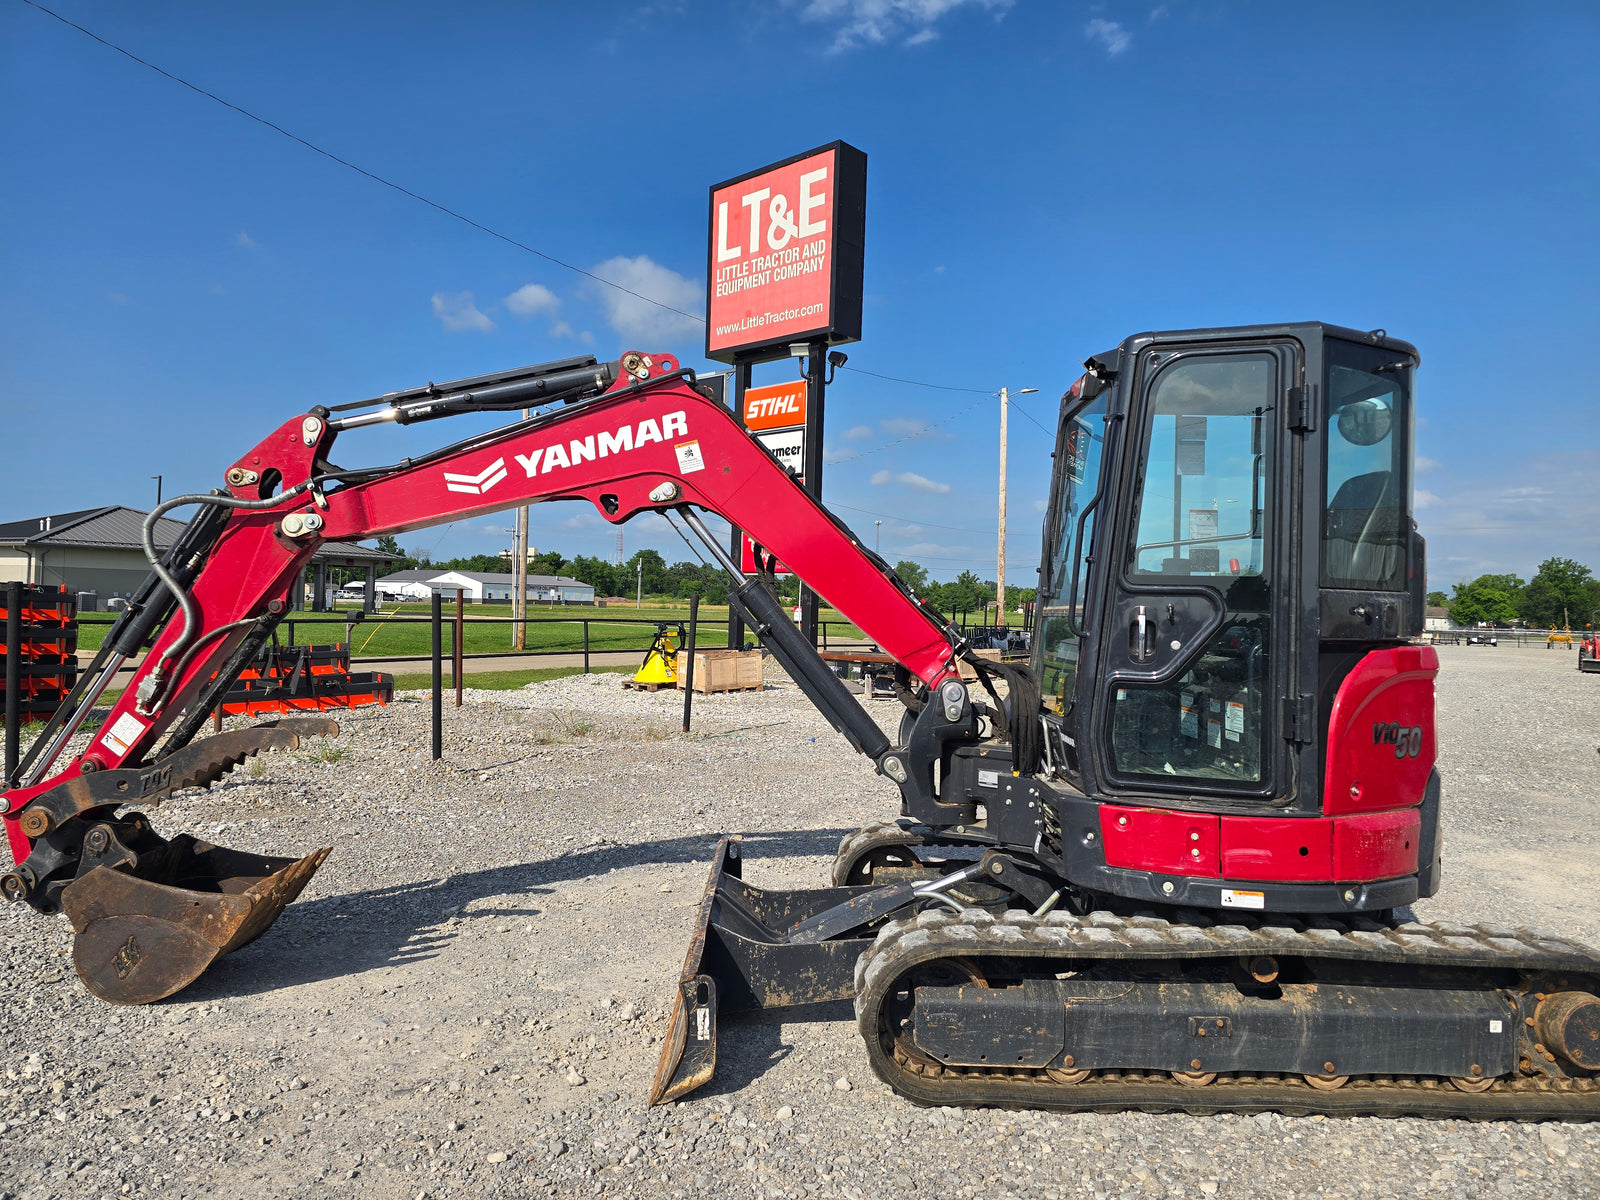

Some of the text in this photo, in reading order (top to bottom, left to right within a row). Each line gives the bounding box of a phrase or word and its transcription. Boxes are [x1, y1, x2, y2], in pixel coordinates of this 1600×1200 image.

[717, 166, 828, 263] LT&E
[716, 239, 826, 283] LITTLE TRACTOR AND
[716, 255, 825, 297] EQUIPMENT COMPANY
[716, 302, 823, 336] www.LittleTractor.com
[746, 394, 799, 419] STIHL
[514, 410, 688, 478] YANMAR
[770, 446, 801, 457] rmeer
